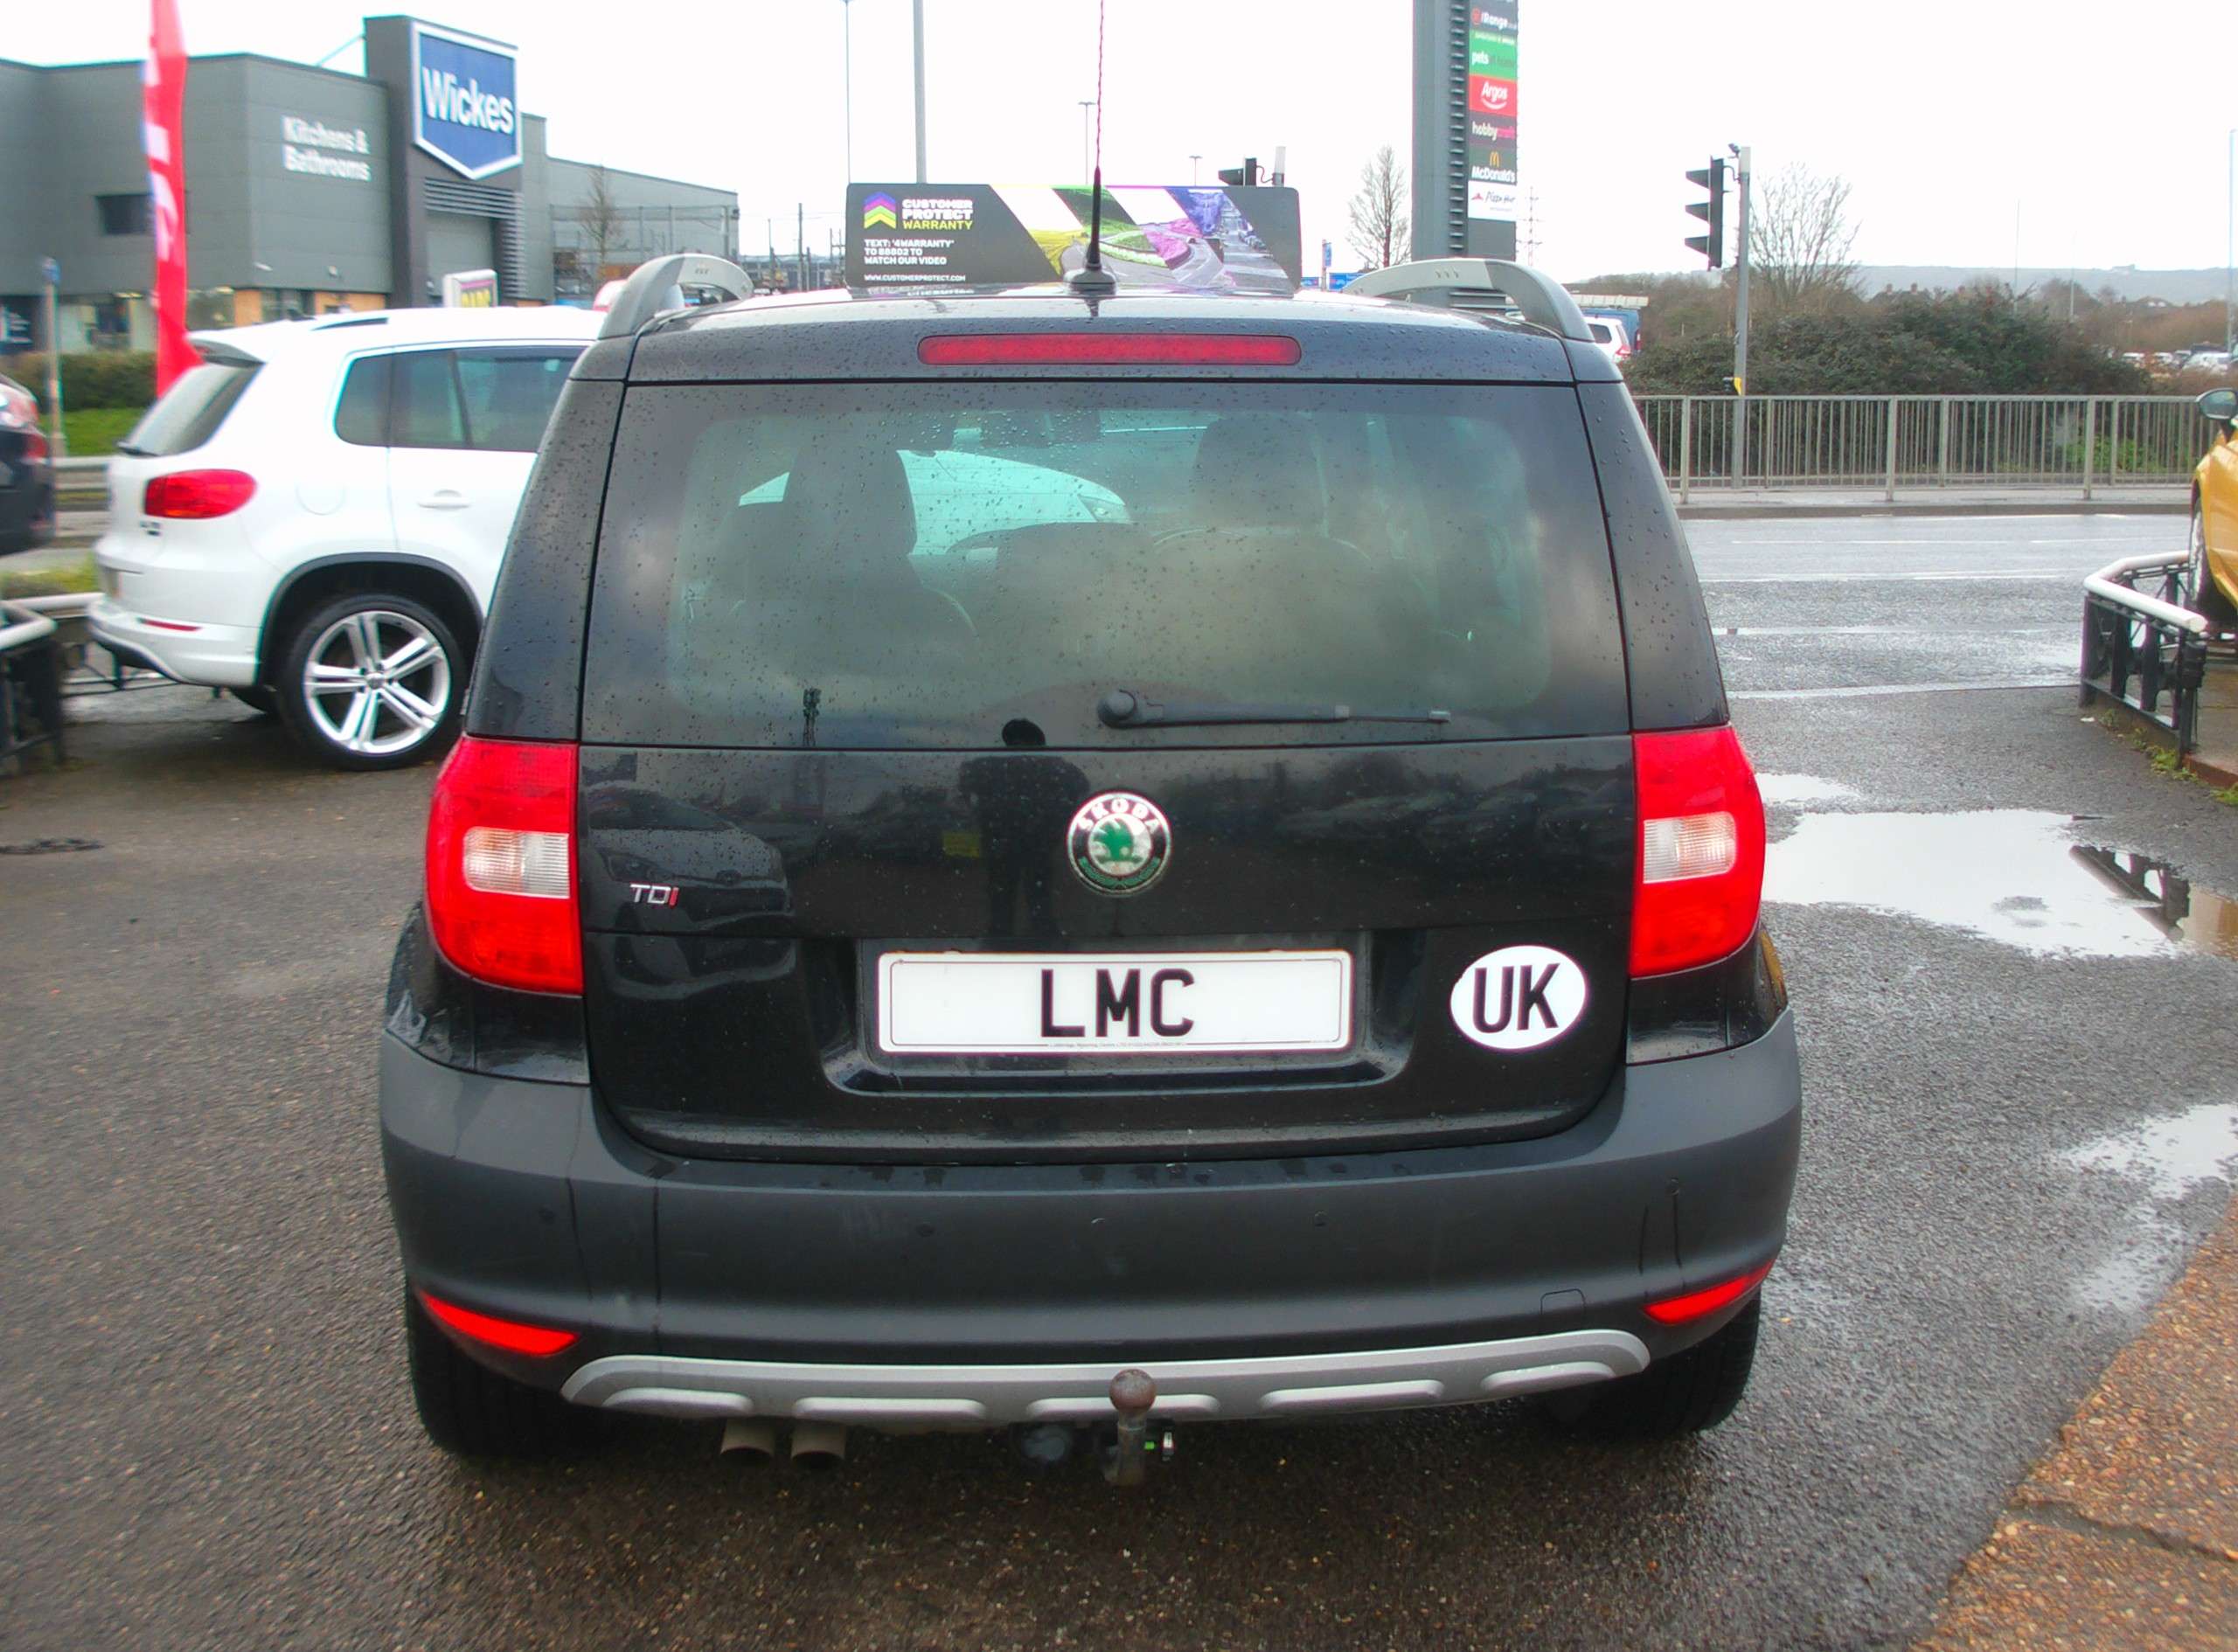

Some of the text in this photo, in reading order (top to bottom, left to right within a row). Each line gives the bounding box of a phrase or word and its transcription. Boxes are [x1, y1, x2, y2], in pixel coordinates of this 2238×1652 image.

[422, 66, 514, 135] Wickes
[1481, 80, 1508, 102] Argos
[281, 115, 371, 155] Kitchens &
[281, 143, 372, 182] Bathrooms
[1471, 165, 1516, 183] McDonald's
[902, 199, 973, 209] CUSTOMER
[902, 209, 973, 220] PROTECT
[902, 220, 973, 230] WARRANTY
[629, 883, 679, 906] TDI
[1041, 968, 1195, 1038] LMC
[1472, 962, 1560, 1033] UK
